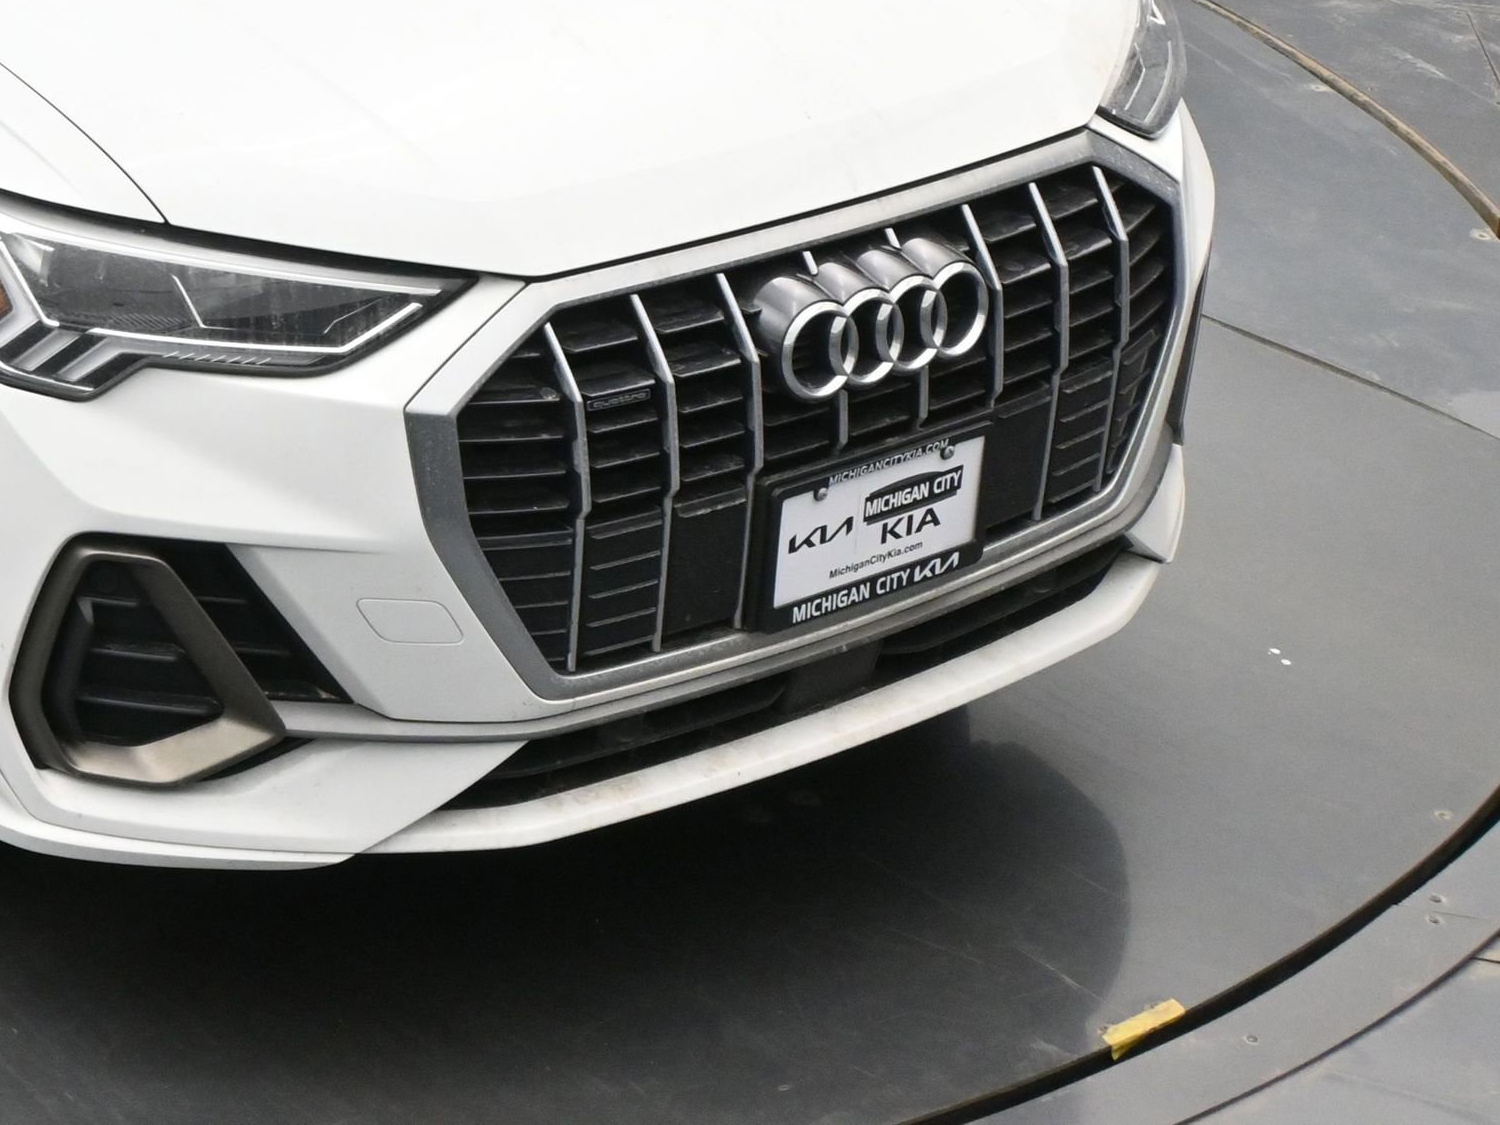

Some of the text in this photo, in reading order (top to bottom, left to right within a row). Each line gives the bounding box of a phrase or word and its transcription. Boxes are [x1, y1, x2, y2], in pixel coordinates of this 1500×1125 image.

[828, 438, 950, 486] MICHIGANCITYKIA.COM
[864, 469, 962, 518] MICHIGAN CITY
[880, 507, 941, 545] KIA
[829, 540, 923, 579] MichiganCityKia.com
[792, 581, 871, 624] MICHIGAN
[875, 568, 911, 595] CITY
